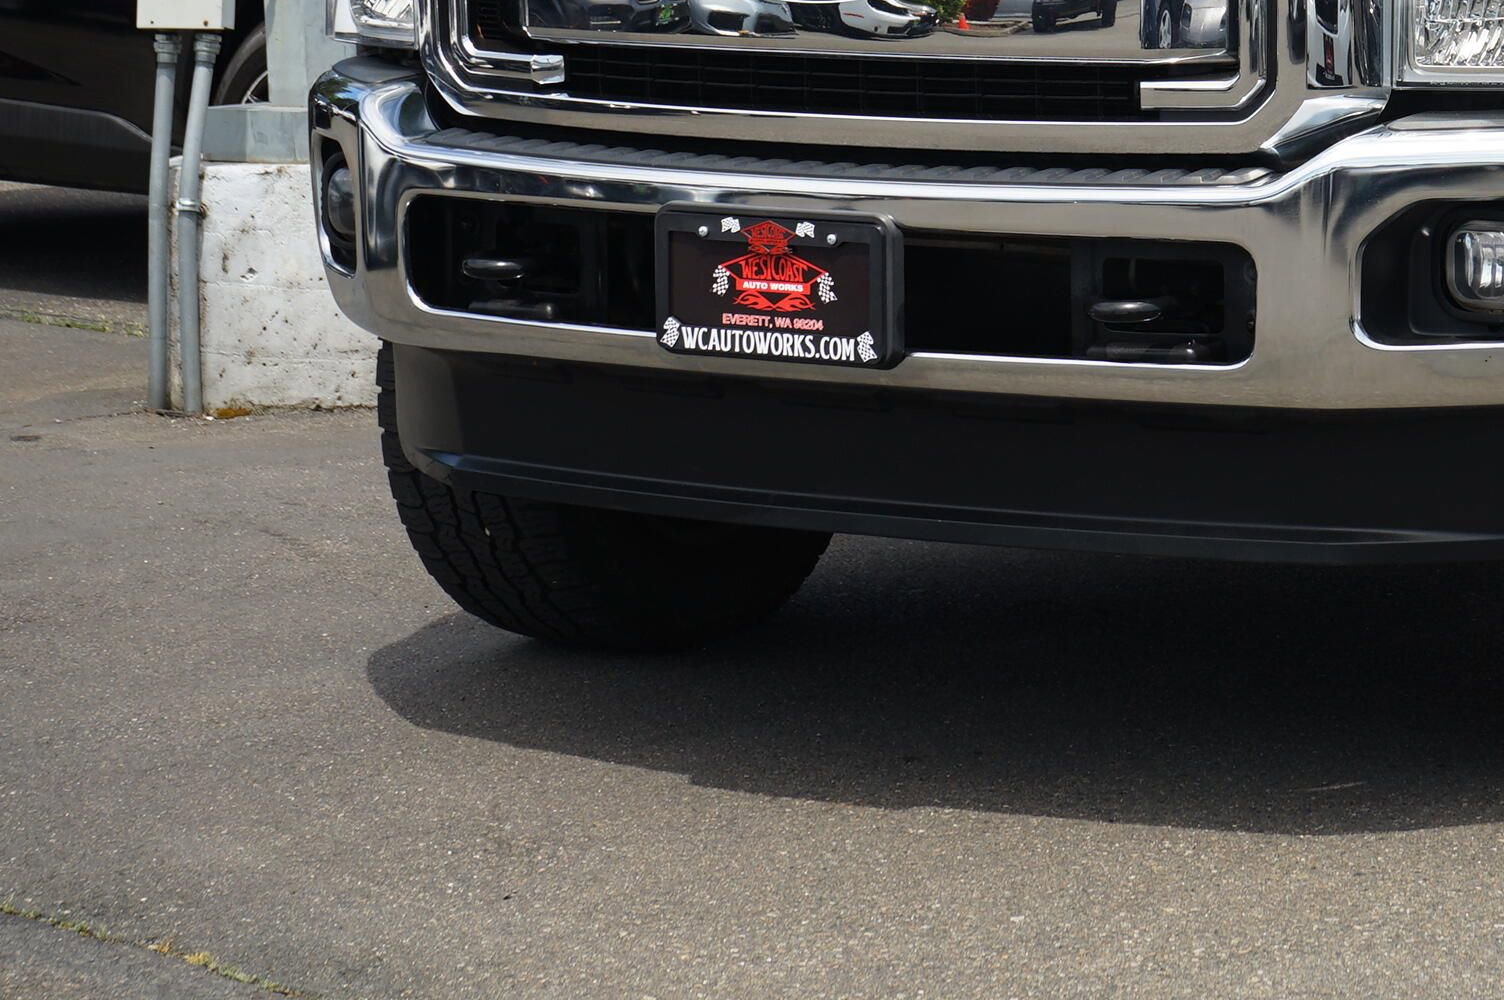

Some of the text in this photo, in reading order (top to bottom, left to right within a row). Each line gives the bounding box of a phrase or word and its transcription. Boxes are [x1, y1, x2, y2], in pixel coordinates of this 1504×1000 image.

[743, 281, 804, 292] AUTO WORKS
[722, 313, 773, 328] EVERETT,
[774, 316, 792, 329] WA
[681, 326, 855, 362] WCAUTOWORKS.COM
